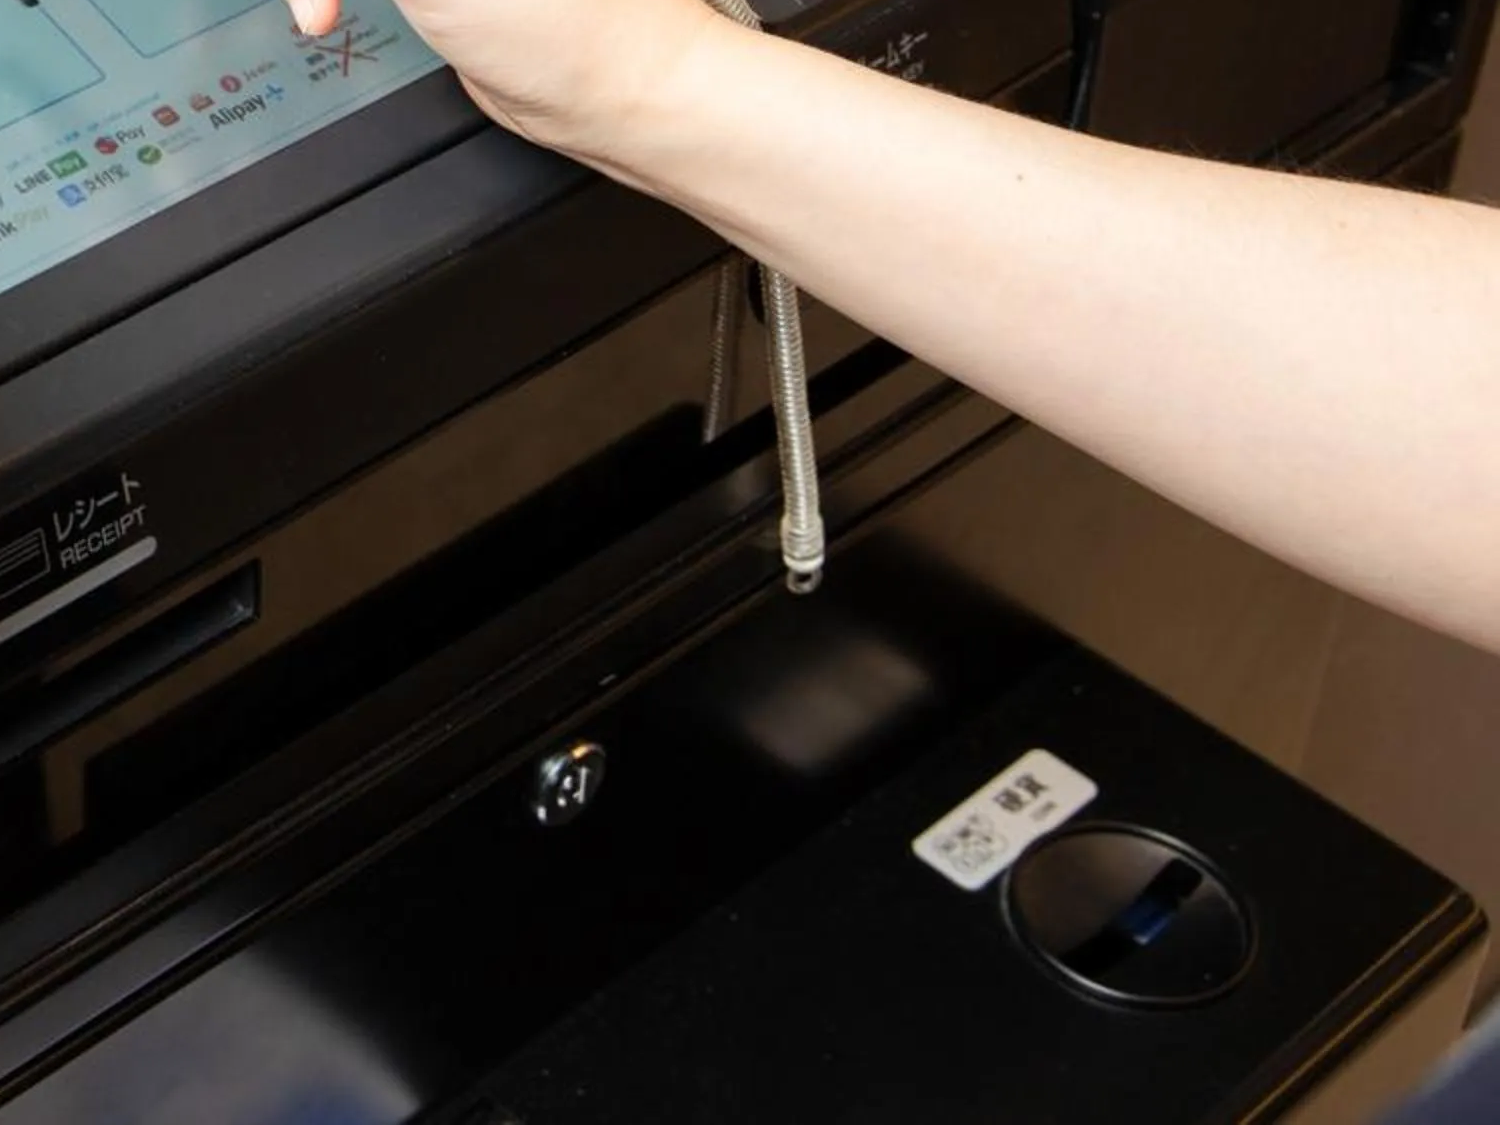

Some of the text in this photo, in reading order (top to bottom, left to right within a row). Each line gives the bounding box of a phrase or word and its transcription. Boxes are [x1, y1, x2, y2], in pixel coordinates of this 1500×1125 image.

[858, 32, 928, 68] ームキー
[14, 169, 53, 195] LINE
[53, 473, 142, 542] レシート
[60, 505, 147, 569] RECEIPT
